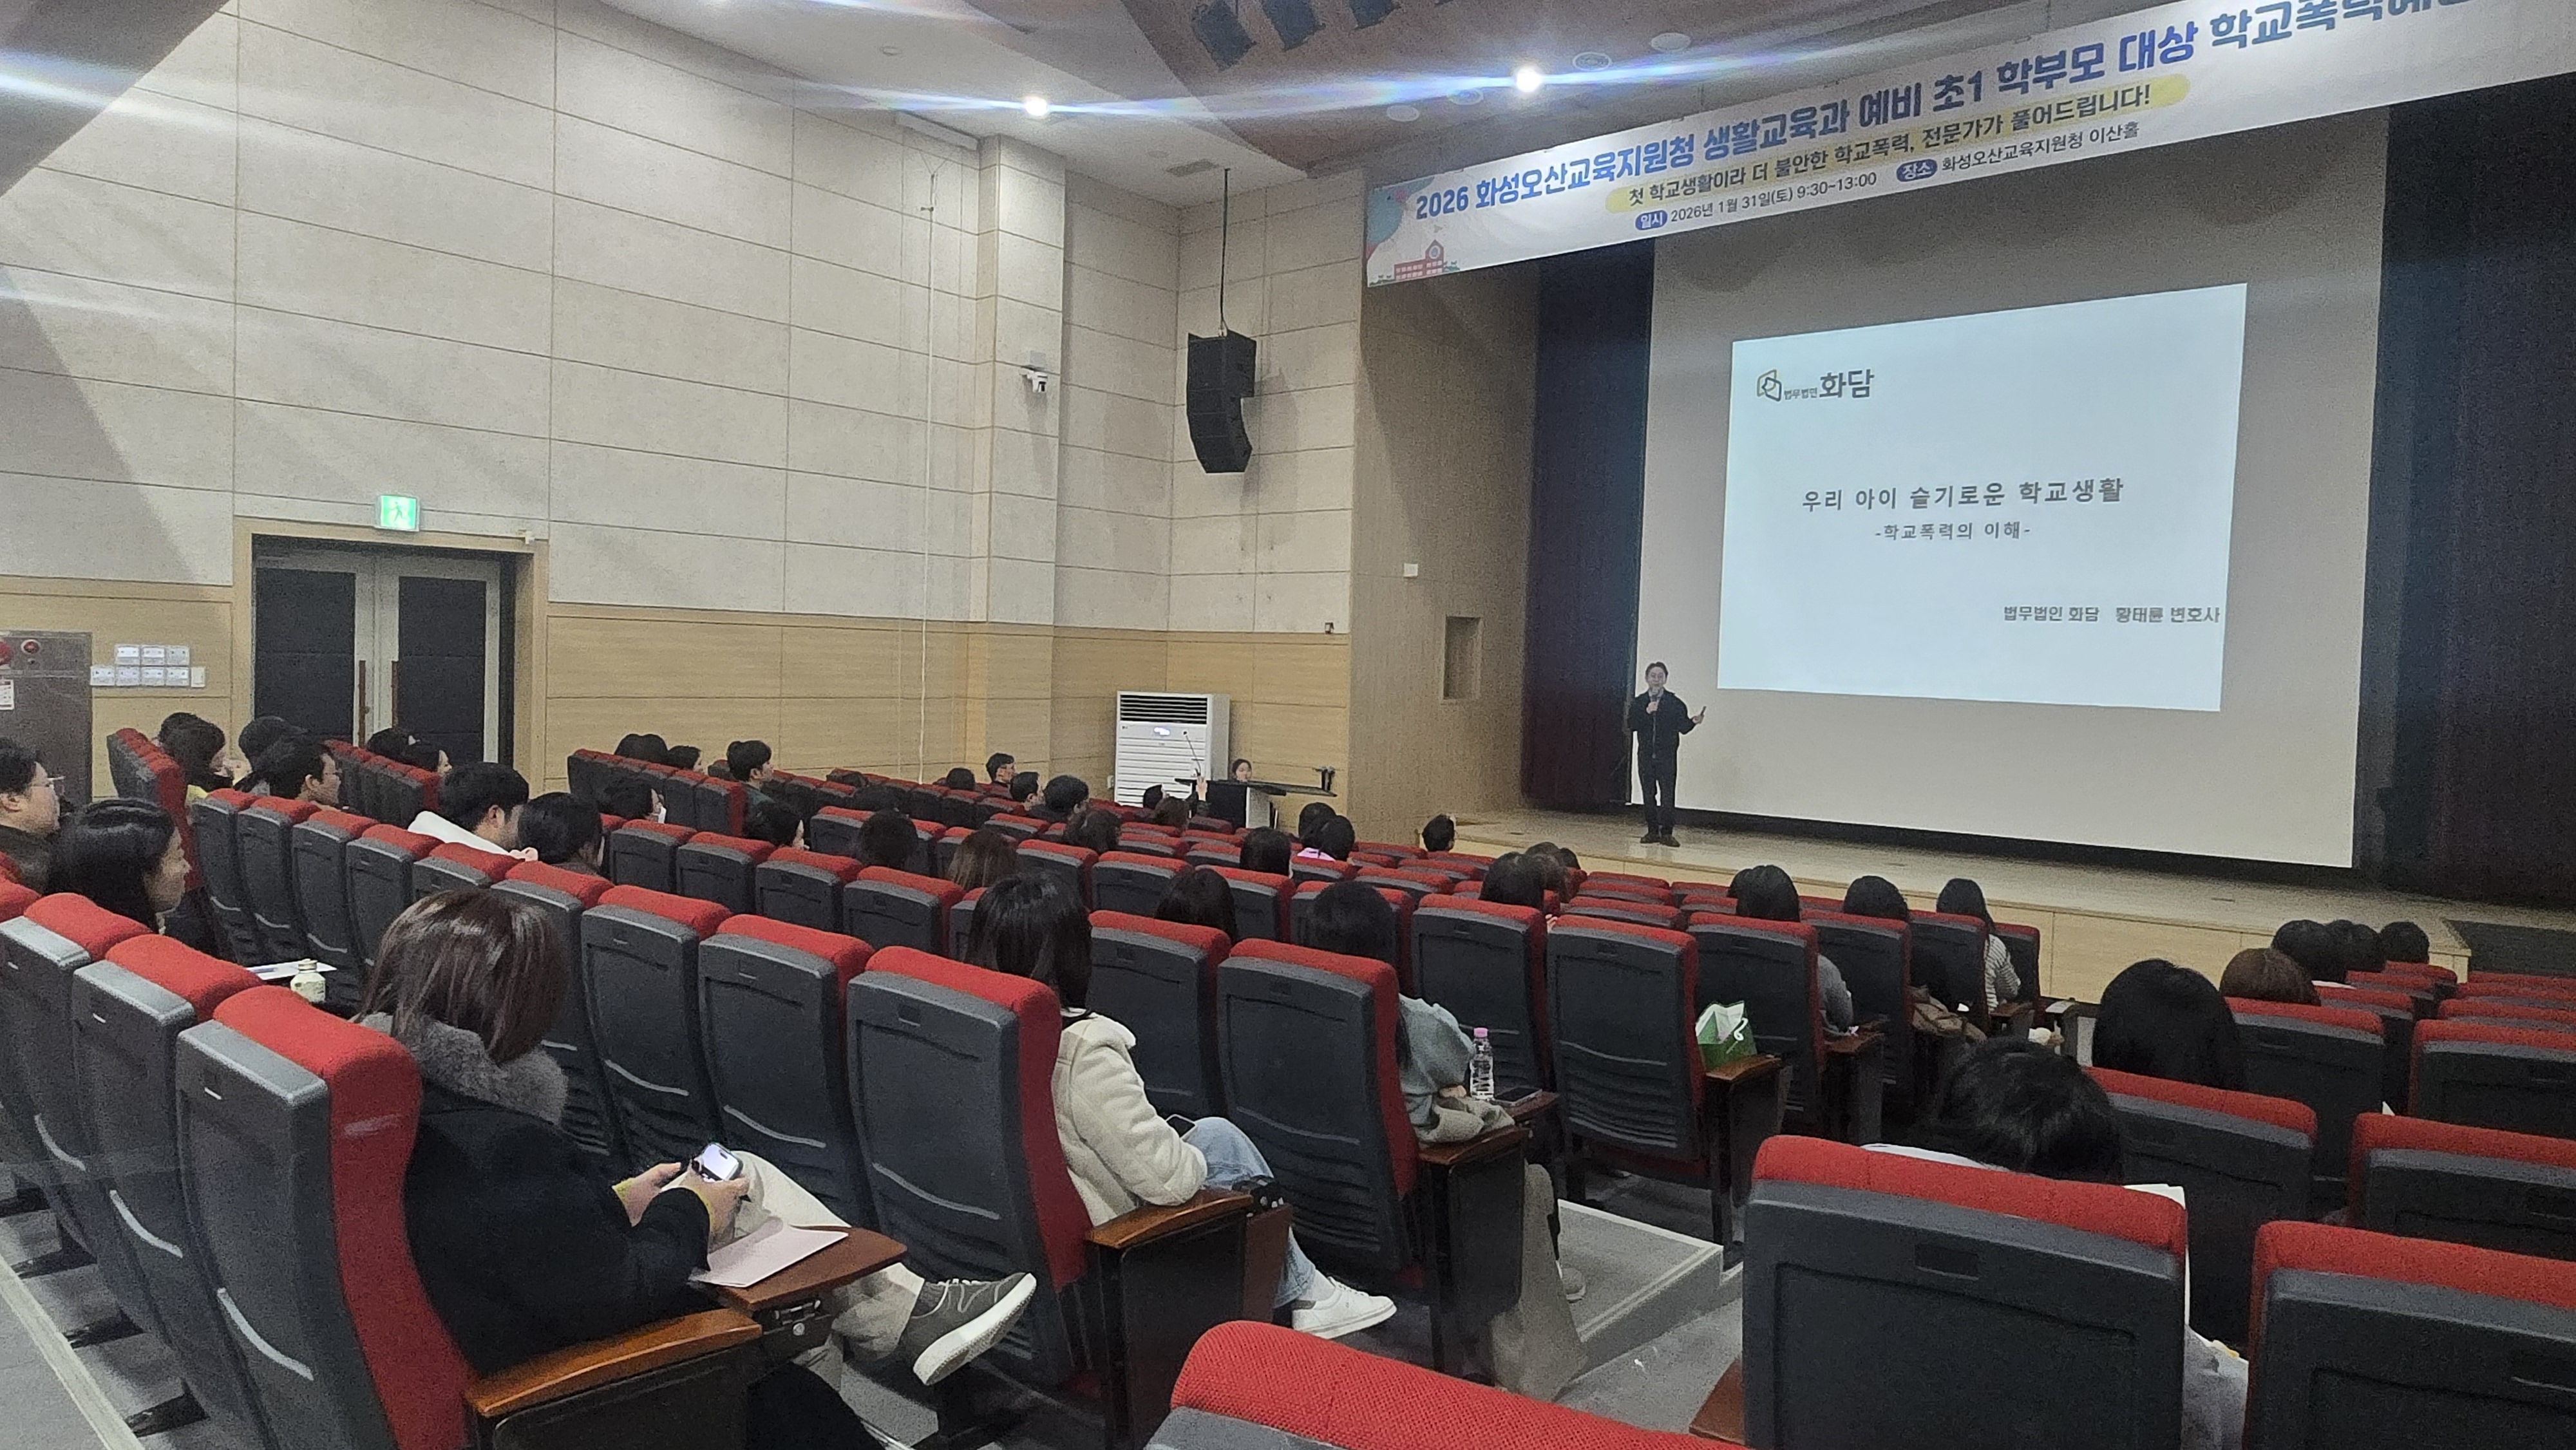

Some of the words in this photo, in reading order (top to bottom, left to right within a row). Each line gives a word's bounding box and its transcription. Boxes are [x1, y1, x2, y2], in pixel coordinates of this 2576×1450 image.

[1416, 186, 1469, 220] 2026
[1475, 133, 1694, 209] 화성오산교육지원청
[1703, 99, 1850, 161] 생활교육과
[1859, 82, 1922, 128] 예비
[1933, 70, 1983, 112] 초1
[1997, 42, 2105, 95] 학부모
[2118, 21, 2199, 71] 대상
[1628, 185, 1643, 207] 첫
[1649, 166, 1746, 202] 학교생활이라
[1752, 162, 1769, 182] 더
[1774, 149, 1829, 178] 불안한
[1834, 133, 1915, 165] 학교폭력,
[1922, 116, 2004, 149] 전문가가
[2010, 84, 2150, 132] 풀어드립니다!
[1640, 212, 1663, 229] 일시
[1671, 202, 1714, 222] 2026년
[1718, 197, 1738, 213] 1월
[1741, 187, 1794, 210] 31일(토)
[1797, 172, 1877, 199] 9:30~13:00
[1902, 161, 1933, 180] 장소
[1941, 131, 2083, 172] 화성오산교육지원청
[2089, 120, 2140, 144] 이산홀
[1819, 368, 1875, 399] 화담
[1802, 489, 1842, 513] 우리
[1855, 487, 1897, 510] 아이
[1909, 482, 2005, 509] 슬기로운
[2018, 477, 2124, 504] 학교생활
[2003, 605, 2063, 621] 법무법인
[2068, 607, 2100, 622] 화담
[2170, 607, 2221, 623] 변호사
